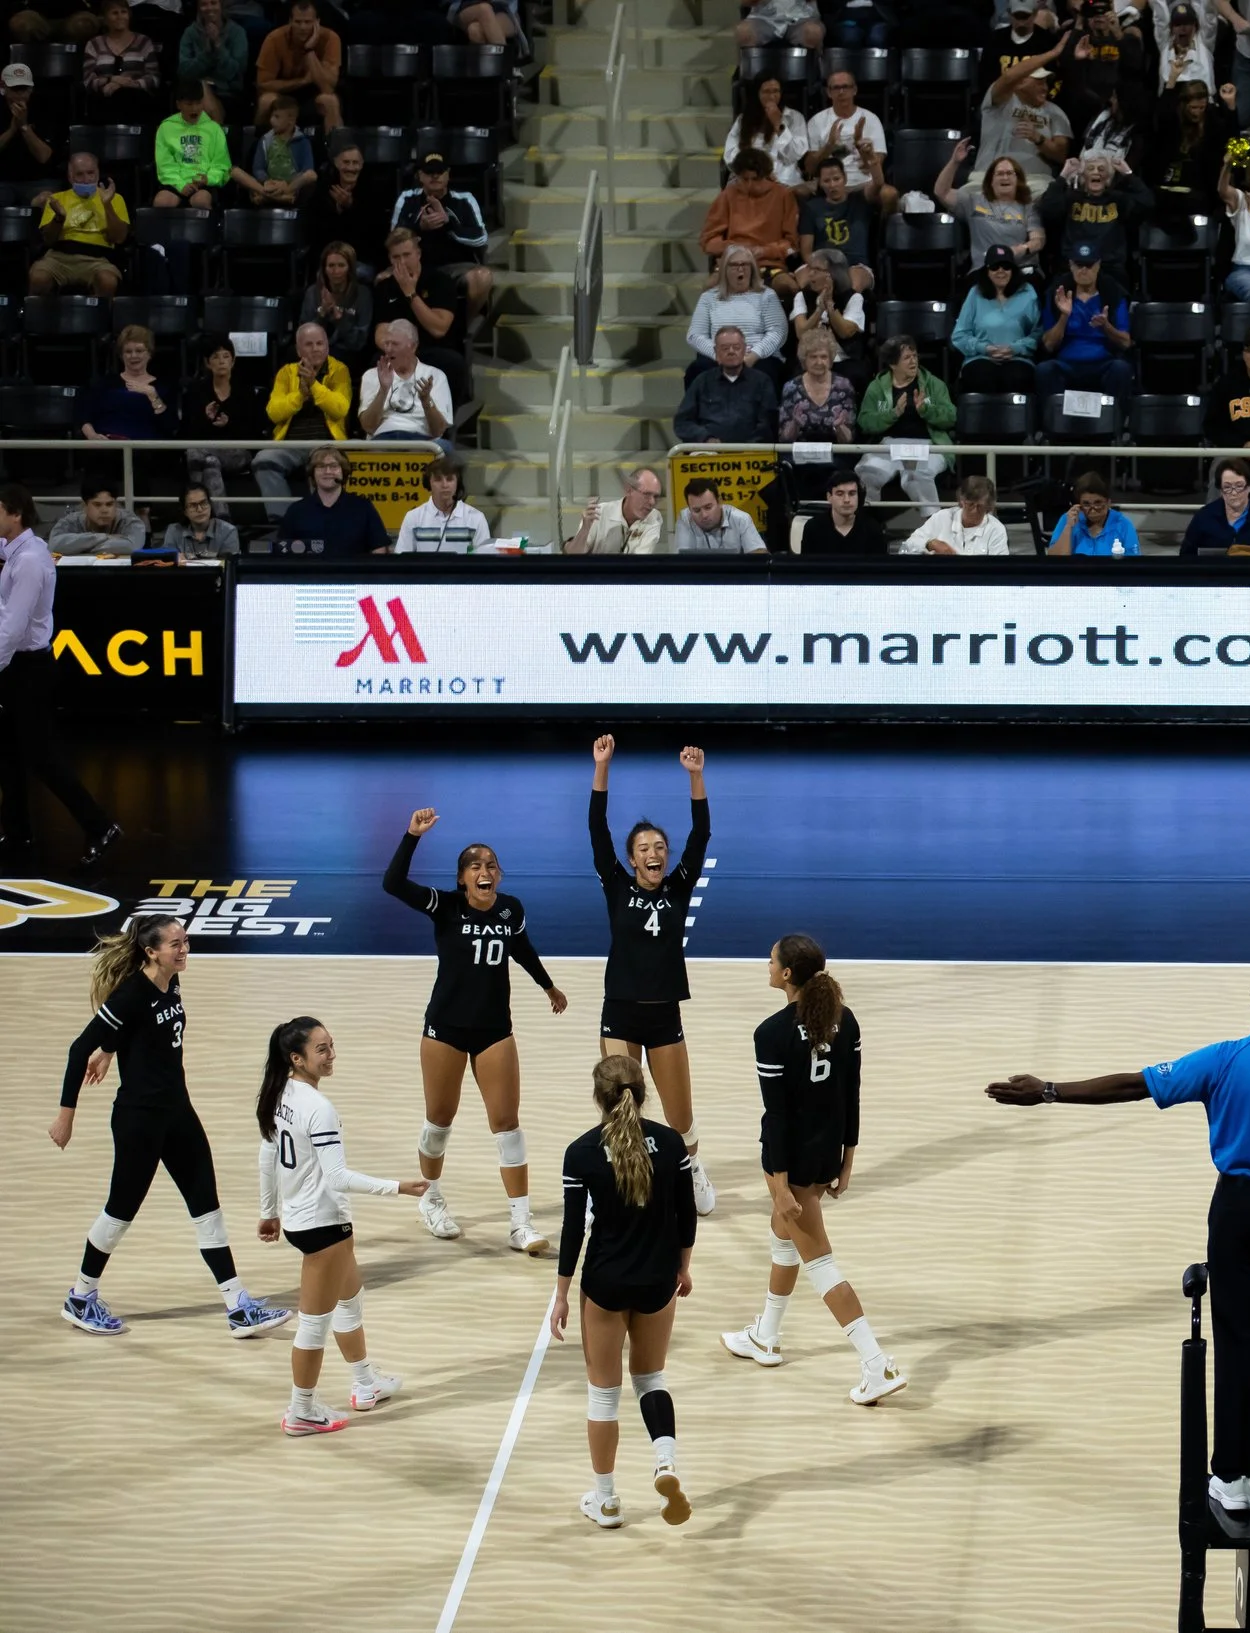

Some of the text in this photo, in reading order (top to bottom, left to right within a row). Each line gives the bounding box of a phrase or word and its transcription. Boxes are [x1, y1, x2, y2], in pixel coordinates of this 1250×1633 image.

[405, 461, 429, 472] 102
[680, 461, 742, 473] SECTION
[348, 476, 420, 487] ROWS A-U
[736, 475, 761, 486] A-U
[391, 492, 419, 501] 8-14
[737, 490, 756, 501] 1-7
[52, 628, 204, 677] ACH
[356, 677, 505, 695] MARRIOTT
[148, 878, 298, 898] THE
[132, 897, 274, 917] BIG
[461, 923, 513, 937] BEACH
[643, 910, 661, 937] 4
[471, 938, 504, 966] 10
[155, 1003, 184, 1025] BEAC
[171, 1020, 184, 1049] 3
[809, 1042, 832, 1083] 6
